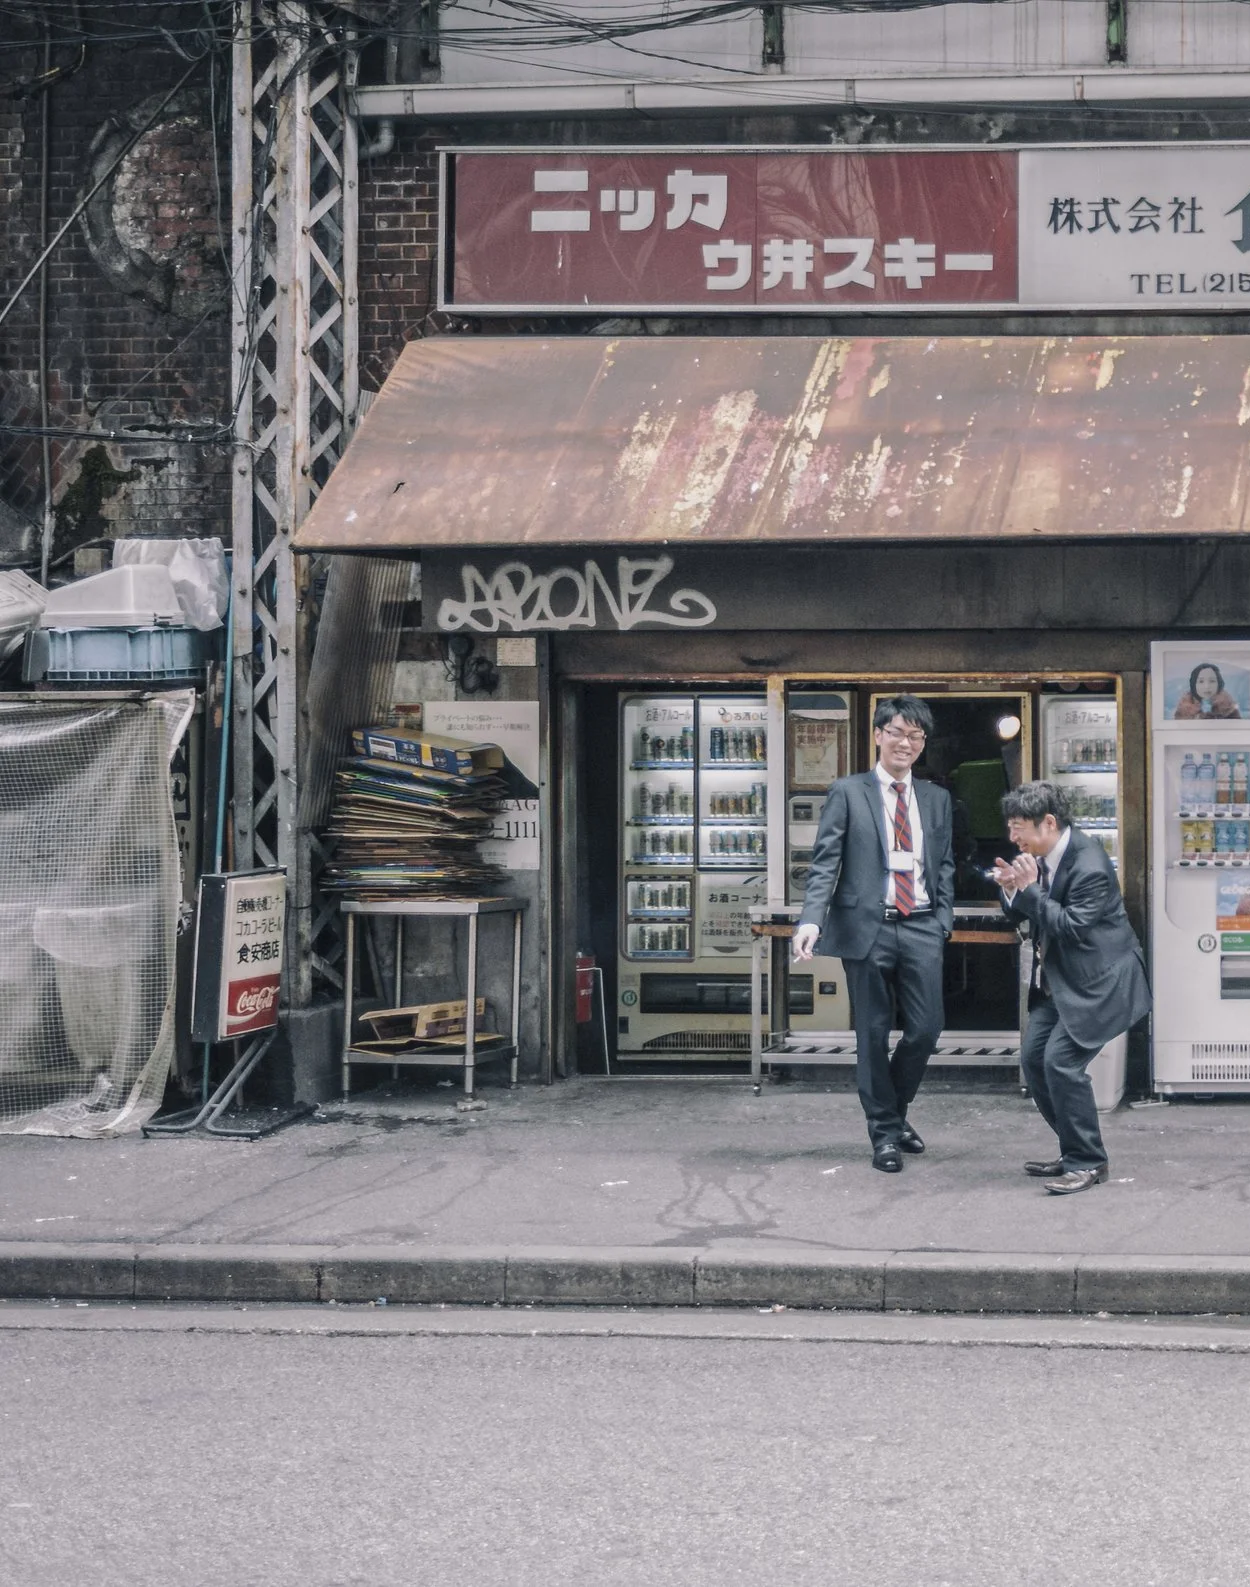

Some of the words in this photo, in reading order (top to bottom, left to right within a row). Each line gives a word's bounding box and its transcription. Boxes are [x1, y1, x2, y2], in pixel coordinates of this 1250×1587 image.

[531, 169, 728, 231] ニッカ
[1047, 196, 1205, 236] 株式会社
[702, 238, 994, 290] ウ井スキー
[237, 939, 280, 965] 食安商店
